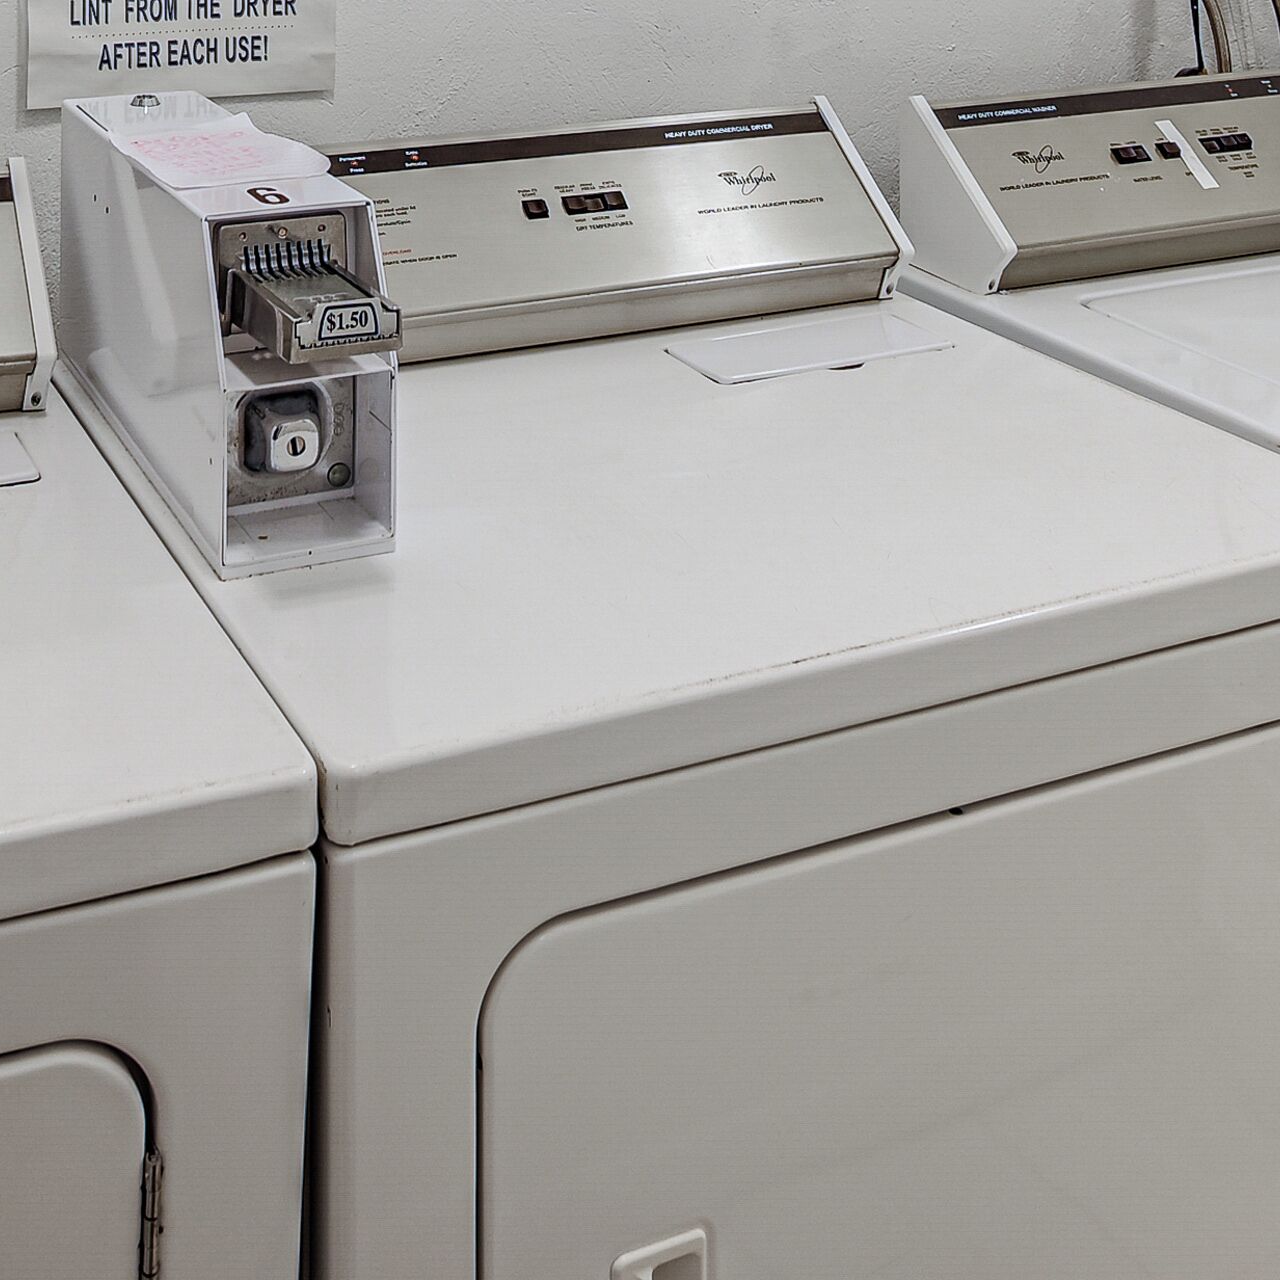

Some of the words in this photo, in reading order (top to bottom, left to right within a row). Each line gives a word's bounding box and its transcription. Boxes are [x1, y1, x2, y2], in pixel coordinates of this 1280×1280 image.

[99, 41, 160, 71] AFTER
[168, 38, 218, 67] EACH
[225, 36, 268, 63] USE!
[688, 129, 706, 137] DUTY
[707, 126, 750, 134] COMMERCIAL
[1018, 152, 1064, 165] Whirlpool
[723, 172, 776, 186] Whirlpool
[247, 187, 290, 205] 6
[789, 197, 823, 205] PRODUCTS
[327, 310, 368, 333] $1.50
